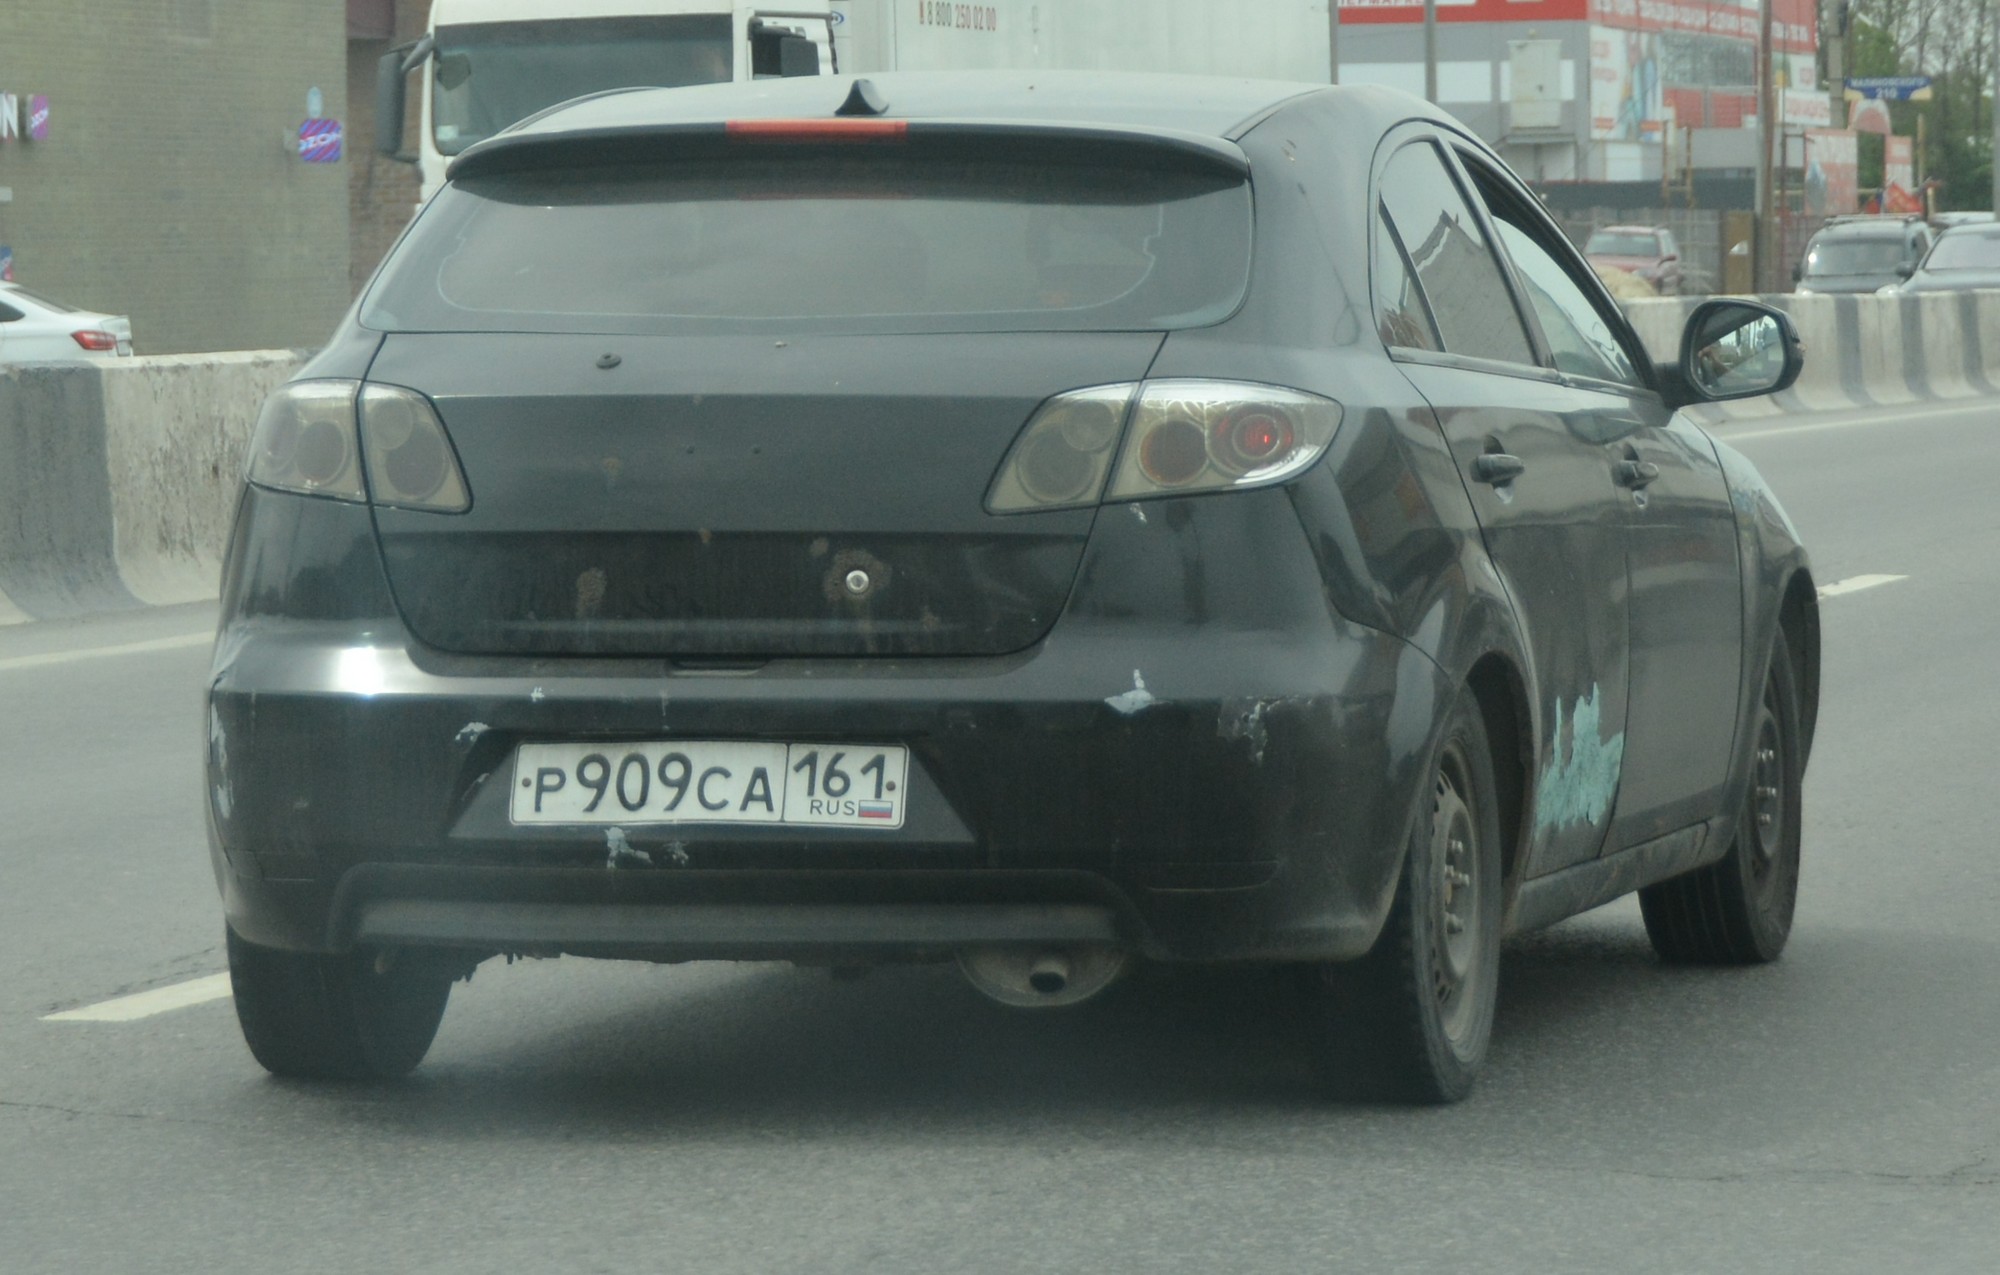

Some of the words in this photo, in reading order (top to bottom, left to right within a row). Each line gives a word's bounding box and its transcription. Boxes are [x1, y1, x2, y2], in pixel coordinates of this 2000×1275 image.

[927, 1, 933, 25] 8
[936, 1, 952, 27] 800
[955, 4, 971, 29] 250
[973, 5, 983, 30] 02
[986, 7, 996, 31] 00
[1876, 88, 1897, 99] 210
[793, 751, 886, 799] 161
[810, 799, 856, 817] RUS
